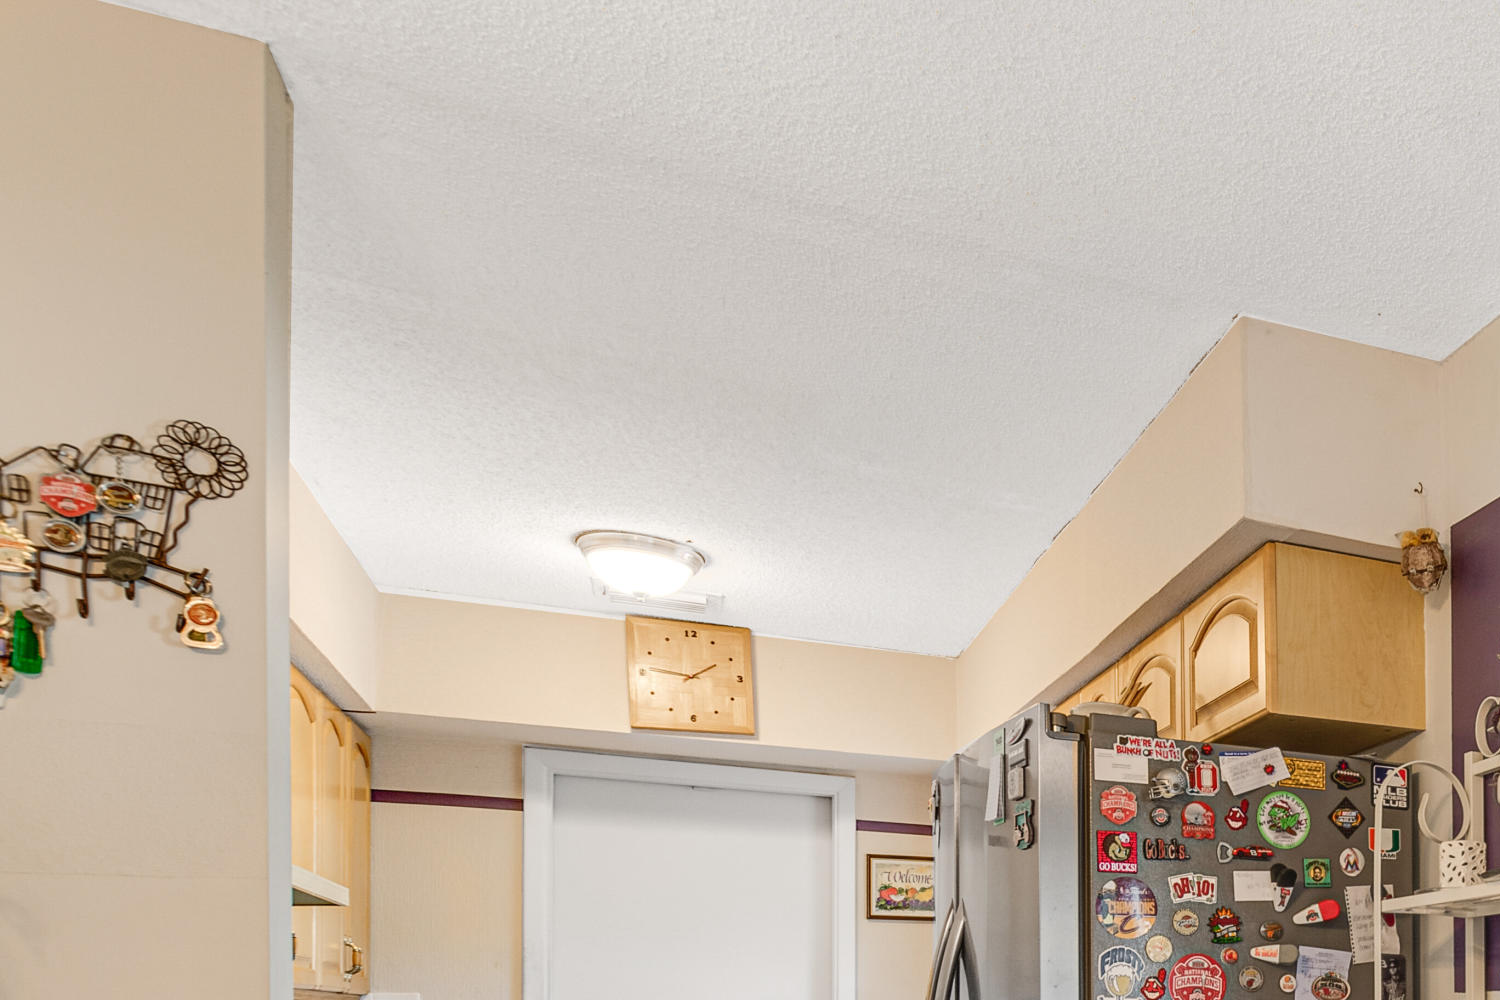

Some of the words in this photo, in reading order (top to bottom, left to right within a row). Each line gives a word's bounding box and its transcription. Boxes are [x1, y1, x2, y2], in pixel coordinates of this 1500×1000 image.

[684, 630, 697, 638] 12
[736, 675, 744, 683] 3
[690, 715, 697, 723] 6
[1128, 737, 1152, 747] WE'RE
[1154, 740, 1168, 749] ALL
[1115, 745, 1142, 756] BUNCH
[1154, 750, 1180, 760] NUTS!
[1099, 862, 1110, 870] GO
[1111, 863, 1137, 872] BUCKS!
[880, 867, 933, 884] Welcome
[1175, 977, 1221, 991] CHAMPIONS
